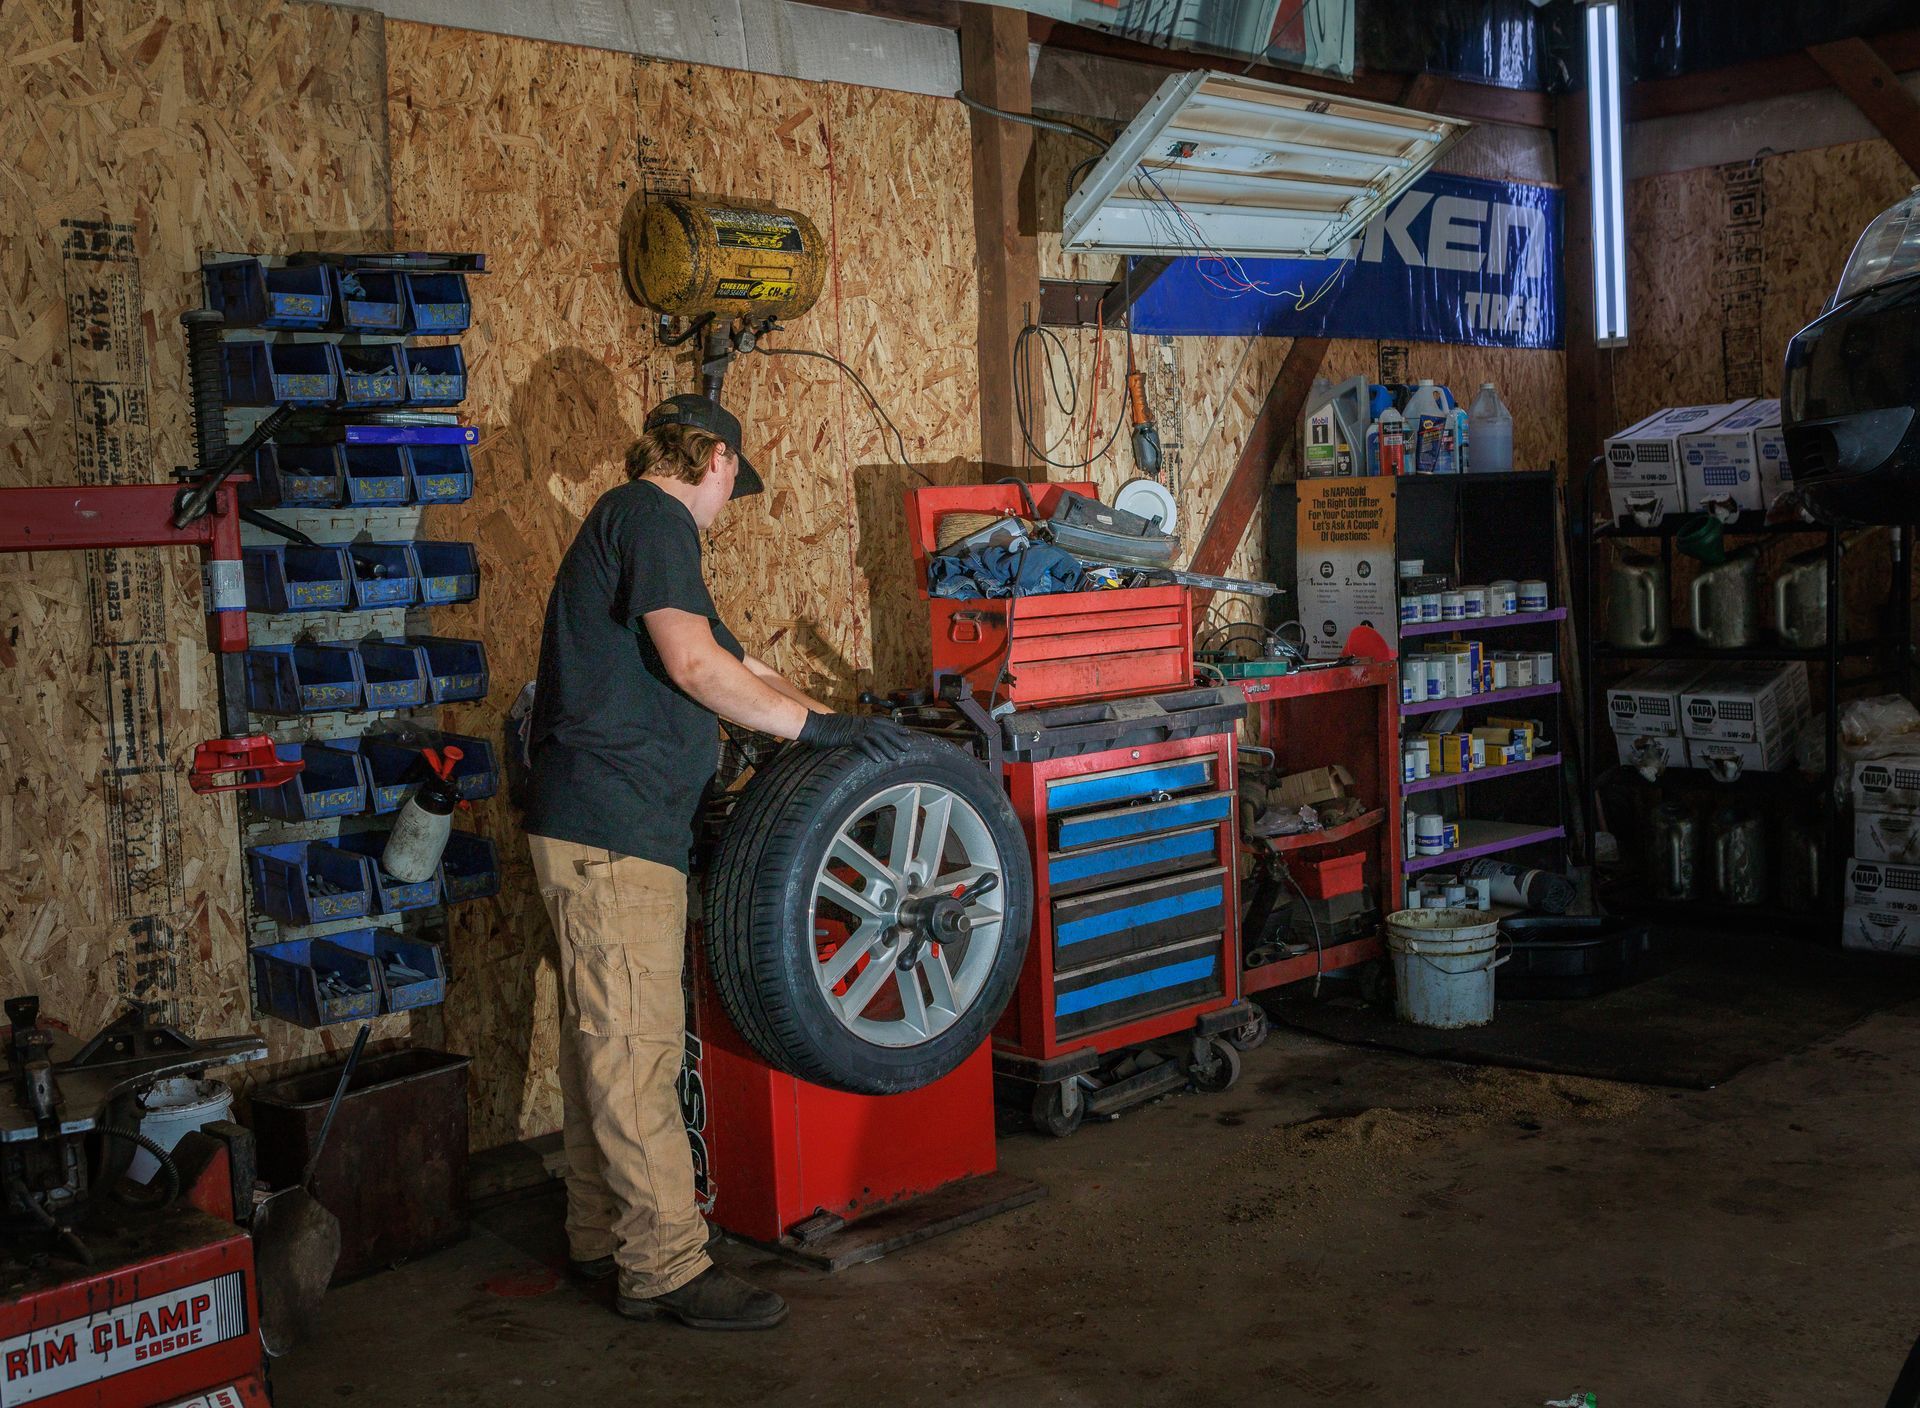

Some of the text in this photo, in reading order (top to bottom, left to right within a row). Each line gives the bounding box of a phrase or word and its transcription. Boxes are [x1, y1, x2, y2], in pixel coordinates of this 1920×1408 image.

[1464, 291, 1540, 332] TIRES
[1312, 416, 1329, 425] Mobil
[1611, 447, 1633, 460] NAPA
[1323, 488, 1330, 497] Is
[1312, 497, 1380, 511] The Right Oil Filter
[1309, 508, 1383, 520] For Your Customer?
[1312, 519, 1379, 531] Let's Ask A Couple
[1320, 531, 1371, 543] Of Questions:
[1614, 700, 1634, 713] NAPA
[1690, 704, 1714, 717] NAPA
[1727, 731, 1751, 739] 5W-20
[1864, 772, 1888, 785] NAPA
[1854, 870, 1878, 885] NAPA
[6, 1293, 211, 1382] RIM CLAMP
[135, 1327, 203, 1362] 5050E
